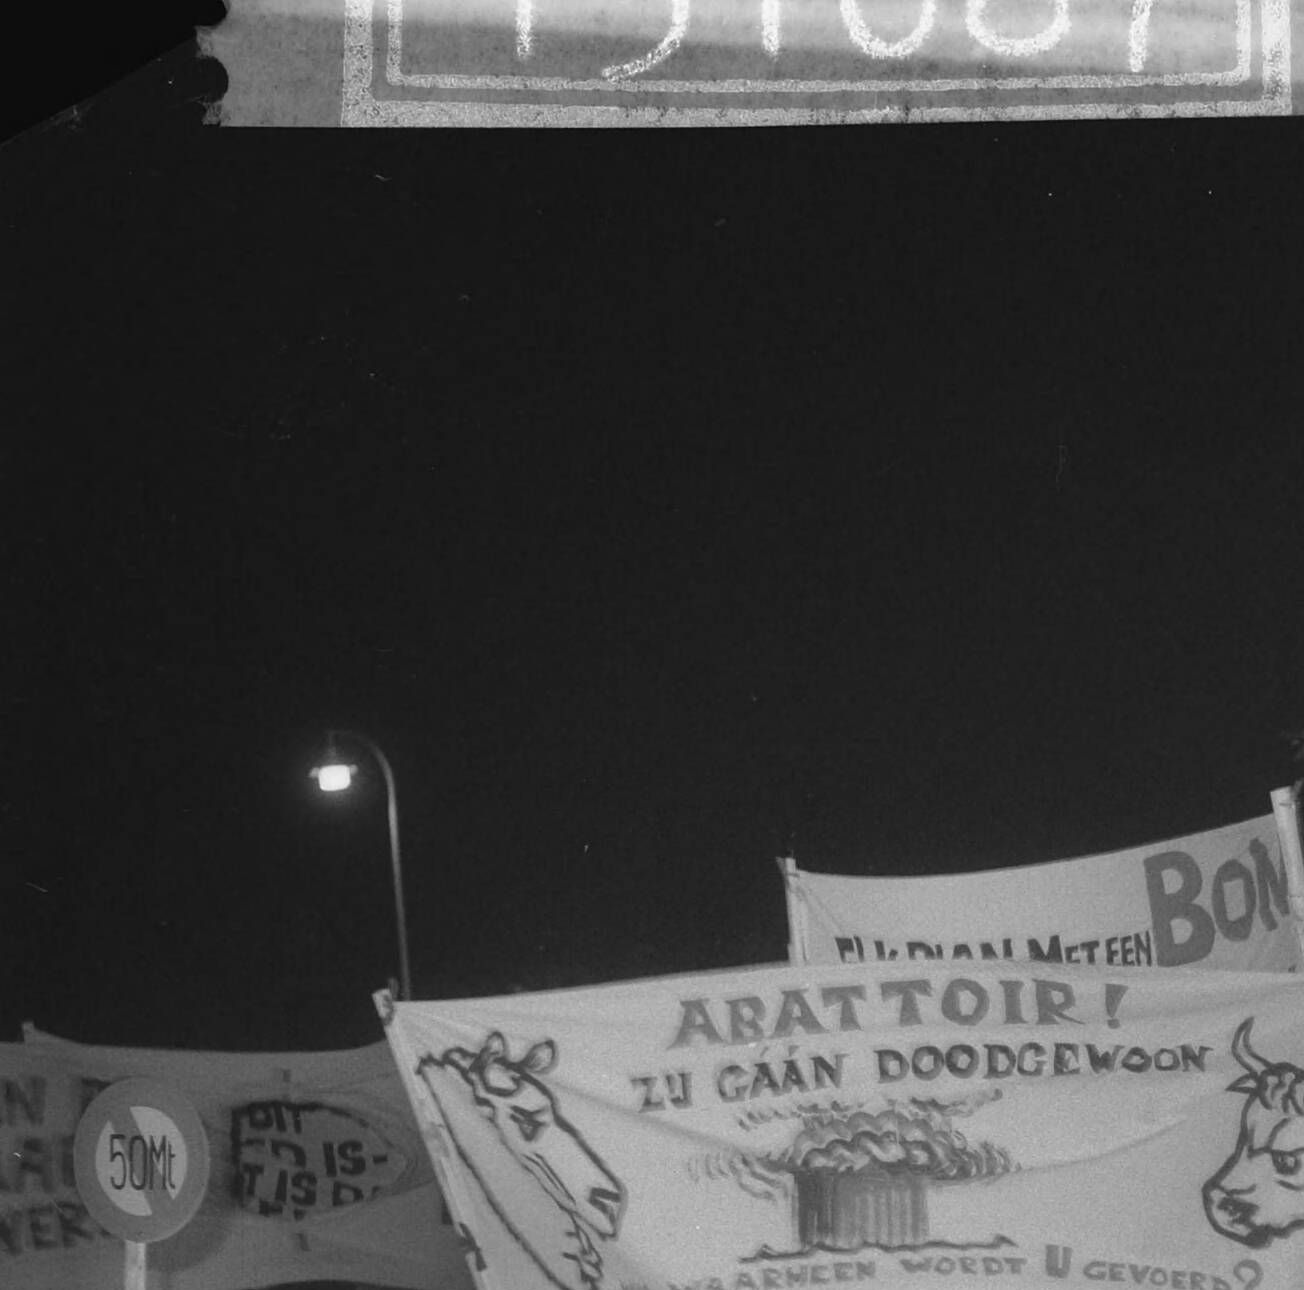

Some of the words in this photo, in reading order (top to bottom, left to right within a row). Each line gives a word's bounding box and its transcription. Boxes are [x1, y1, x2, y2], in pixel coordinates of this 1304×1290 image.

[874, 1042, 1212, 1084] DOODGEWOON
[109, 1134, 176, 1191] 50Mt
[900, 1256, 1028, 1277] WORDT
[1045, 1244, 1073, 1279] U
